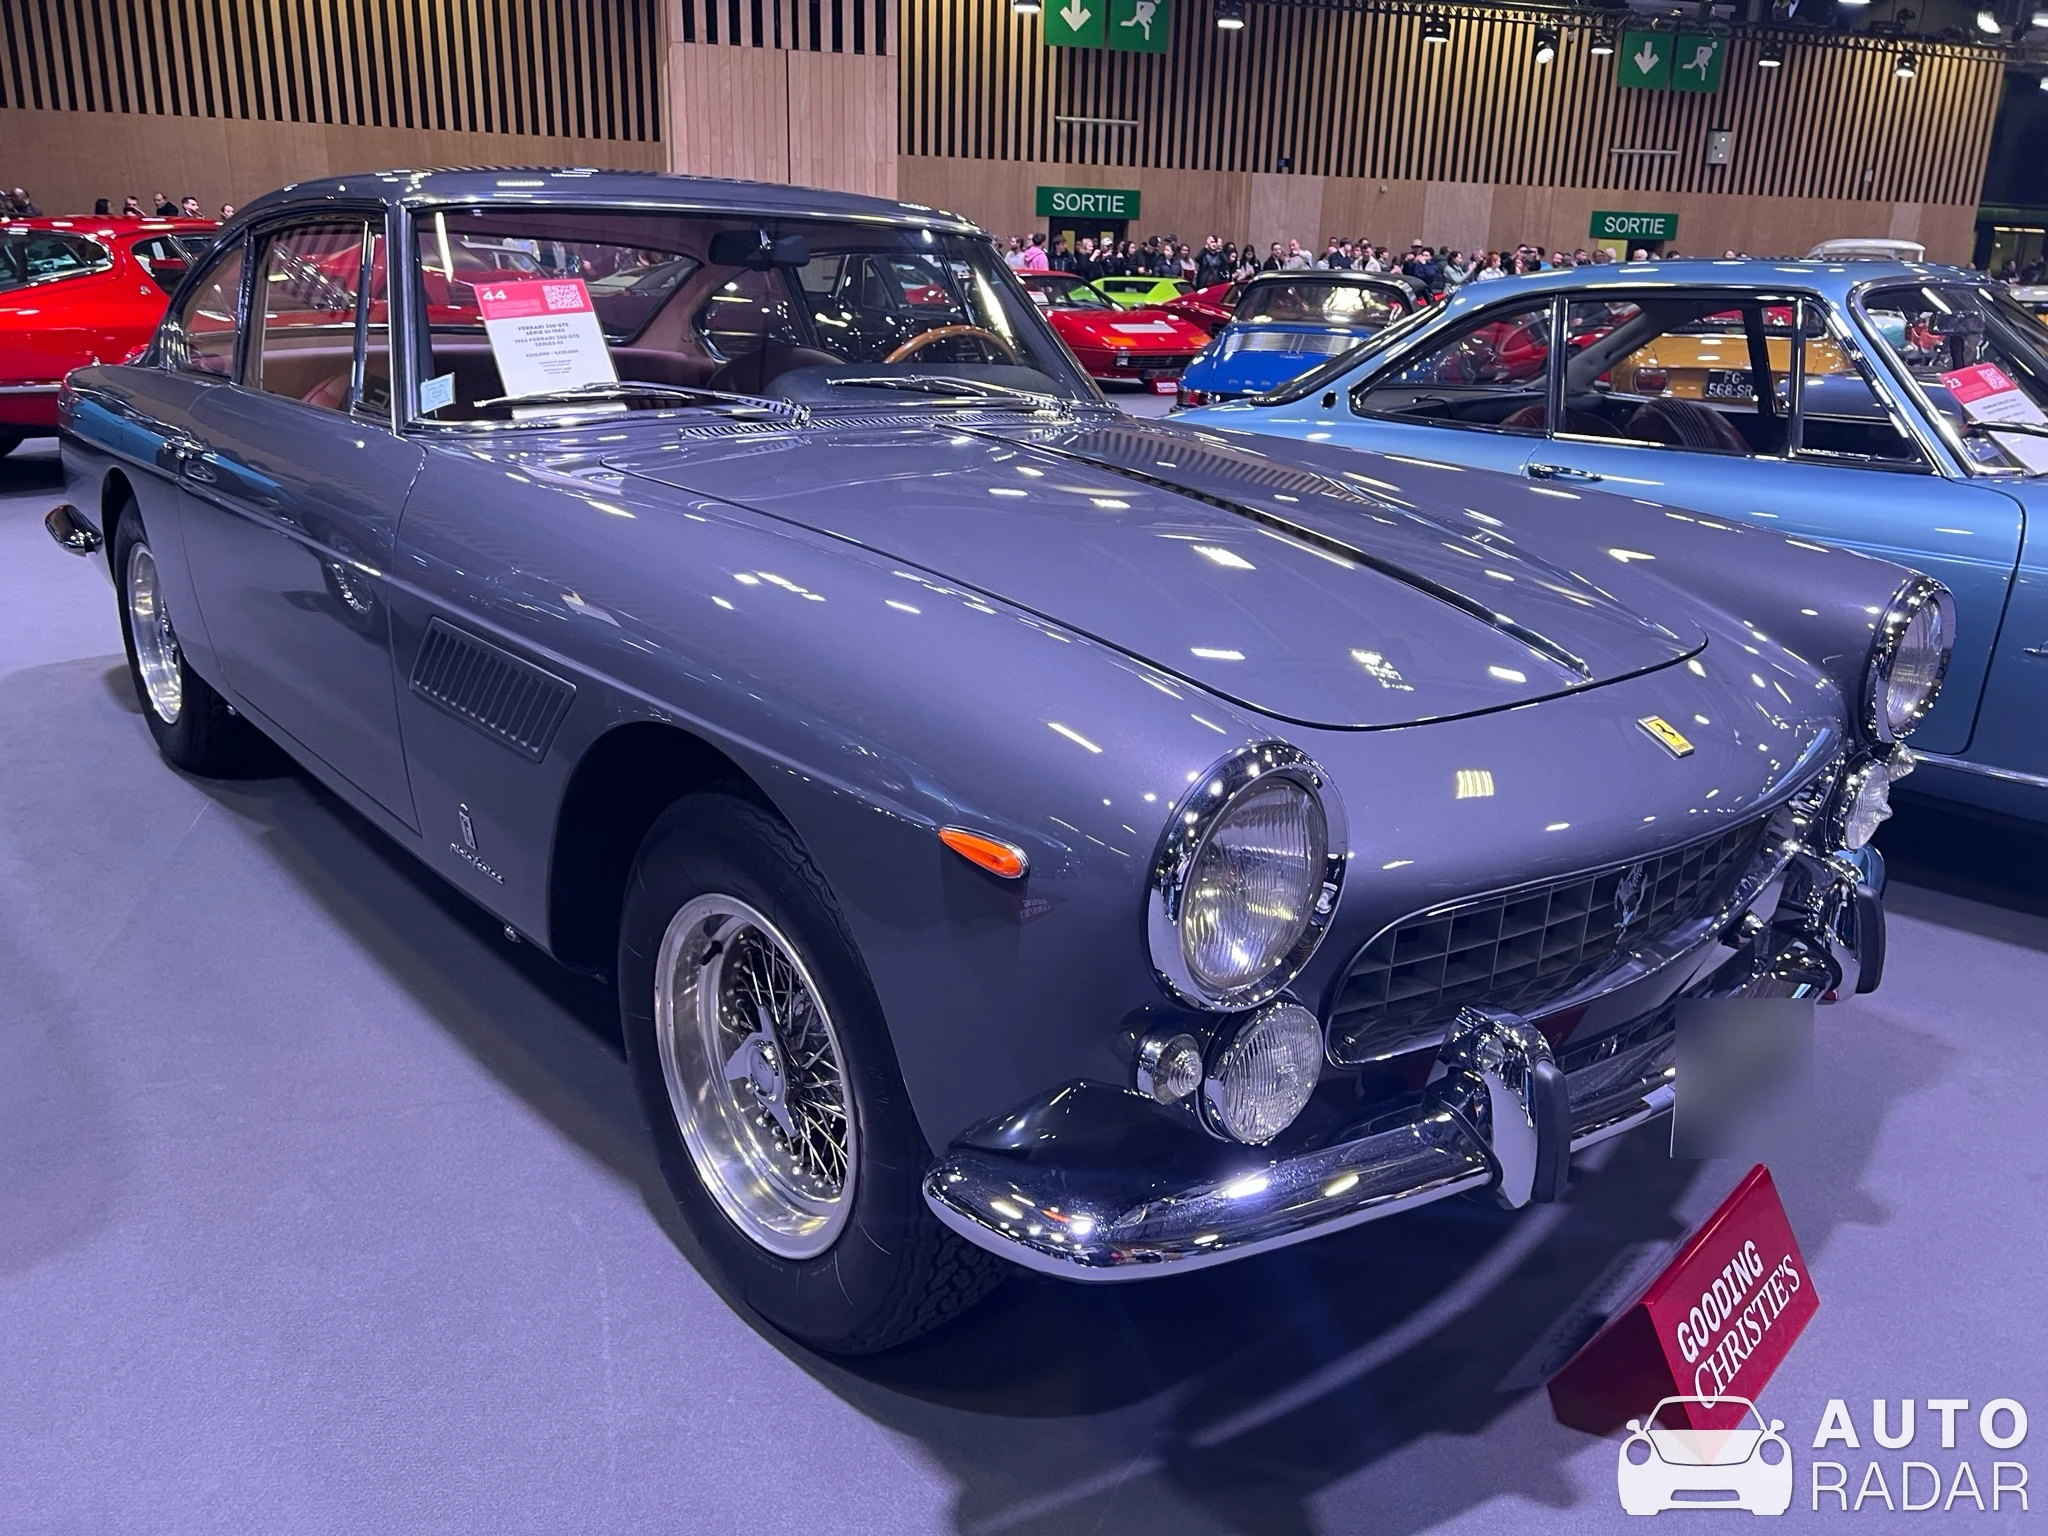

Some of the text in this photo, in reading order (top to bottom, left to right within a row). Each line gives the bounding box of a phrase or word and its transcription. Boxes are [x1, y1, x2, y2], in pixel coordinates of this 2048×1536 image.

[1052, 192, 1125, 213] SORTIE
[1604, 216, 1665, 234] SORTIE
[482, 289, 507, 301] 44
[1708, 382, 1753, 397] 568-SR
[1946, 377, 1962, 389] 23
[1676, 1240, 1764, 1364] GOODING
[1693, 1254, 1801, 1410] CHRISTIE'S
